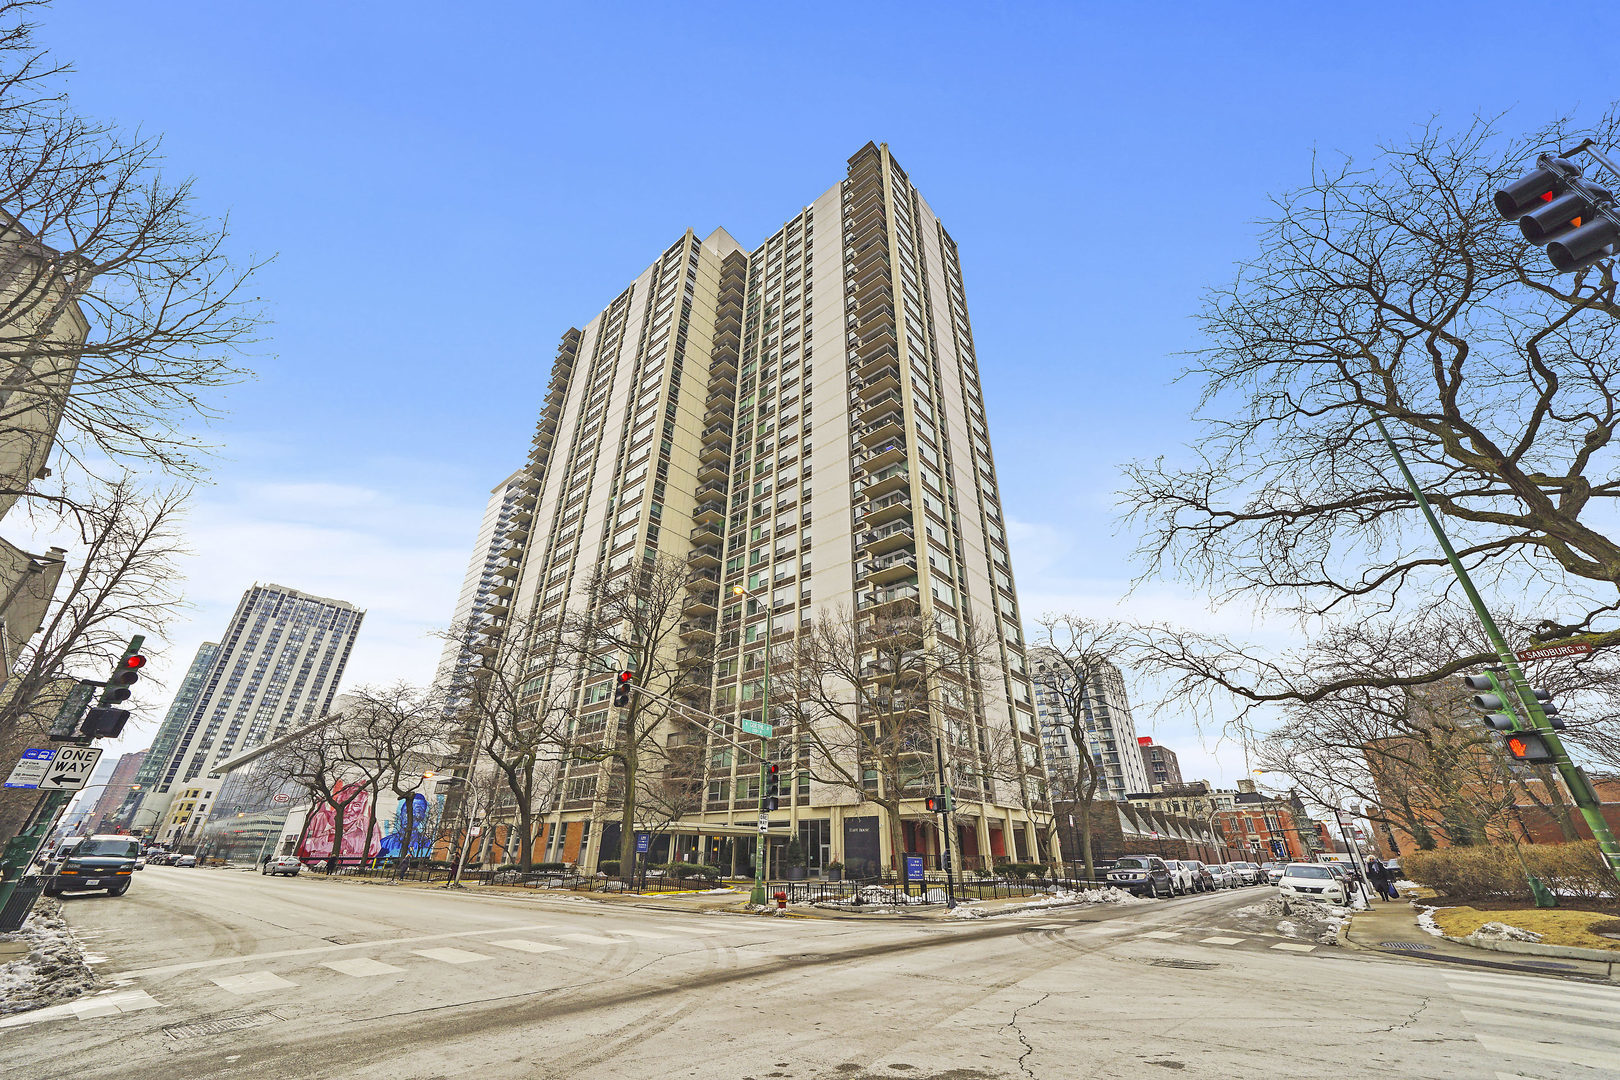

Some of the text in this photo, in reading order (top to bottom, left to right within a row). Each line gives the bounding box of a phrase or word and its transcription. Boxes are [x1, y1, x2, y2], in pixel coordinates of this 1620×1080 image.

[1526, 646, 1575, 659] SANDBURG
[61, 749, 96, 762] ONE
[54, 761, 91, 773] WAY
